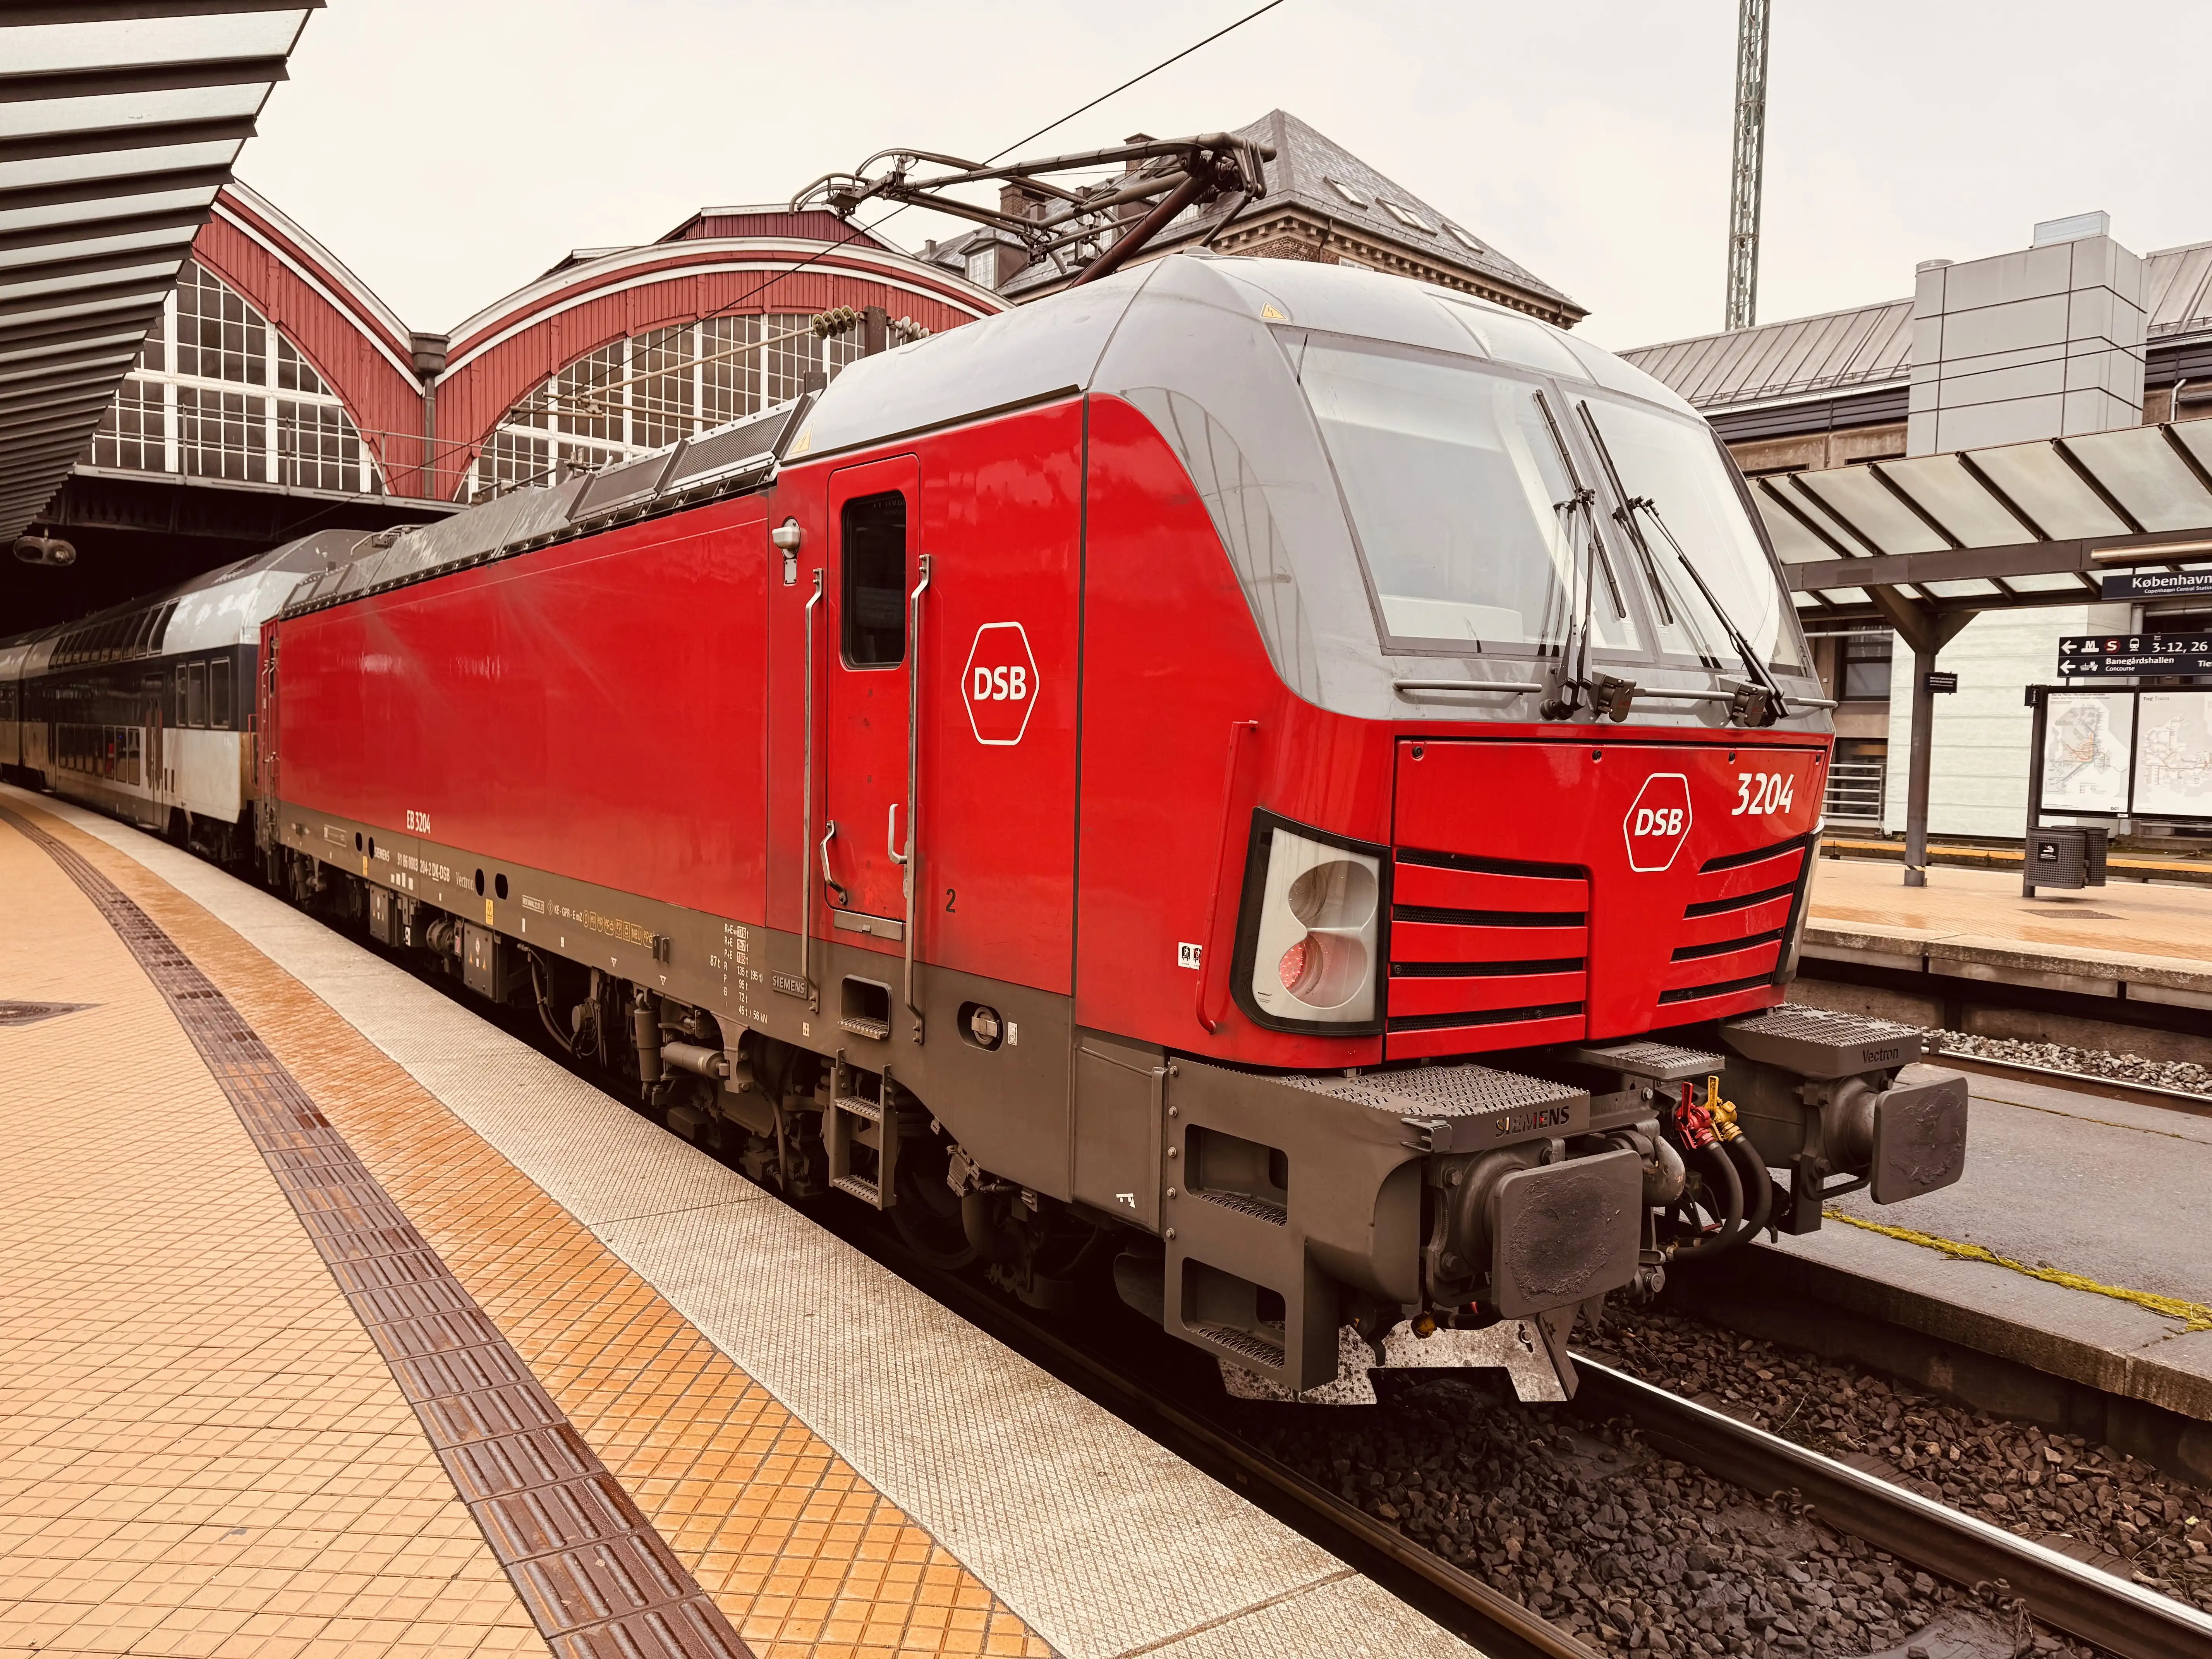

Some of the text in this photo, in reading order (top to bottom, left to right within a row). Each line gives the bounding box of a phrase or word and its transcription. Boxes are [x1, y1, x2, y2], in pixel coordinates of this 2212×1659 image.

[2132, 575, 2212, 588] København
[2106, 641, 2117, 651] S
[2152, 642, 2187, 653] 3-12,
[2191, 641, 2208, 652] 26
[2106, 657, 2174, 665] Banegårdshallen
[974, 666, 1026, 700] DSB
[1731, 773, 1794, 816] 3204
[407, 809, 430, 834] EB 3204
[1634, 808, 1683, 836] DSB
[397, 852, 402, 866] 91
[456, 871, 474, 890] Vectron
[946, 888, 956, 913] 2
[710, 955, 716, 967] 87
[717, 958, 720, 968] t
[724, 961, 727, 970] R
[745, 969, 748, 978] t
[724, 974, 748, 991] P 95 t
[773, 975, 805, 994] SIEMENS
[723, 986, 727, 996] G
[738, 992, 745, 1002] 72
[738, 1005, 745, 1015] 45
[753, 1010, 759, 1021] 56
[760, 1013, 768, 1024] kN
[1863, 1048, 1898, 1064] Vectron
[1496, 1106, 1570, 1138] SIEMENS
